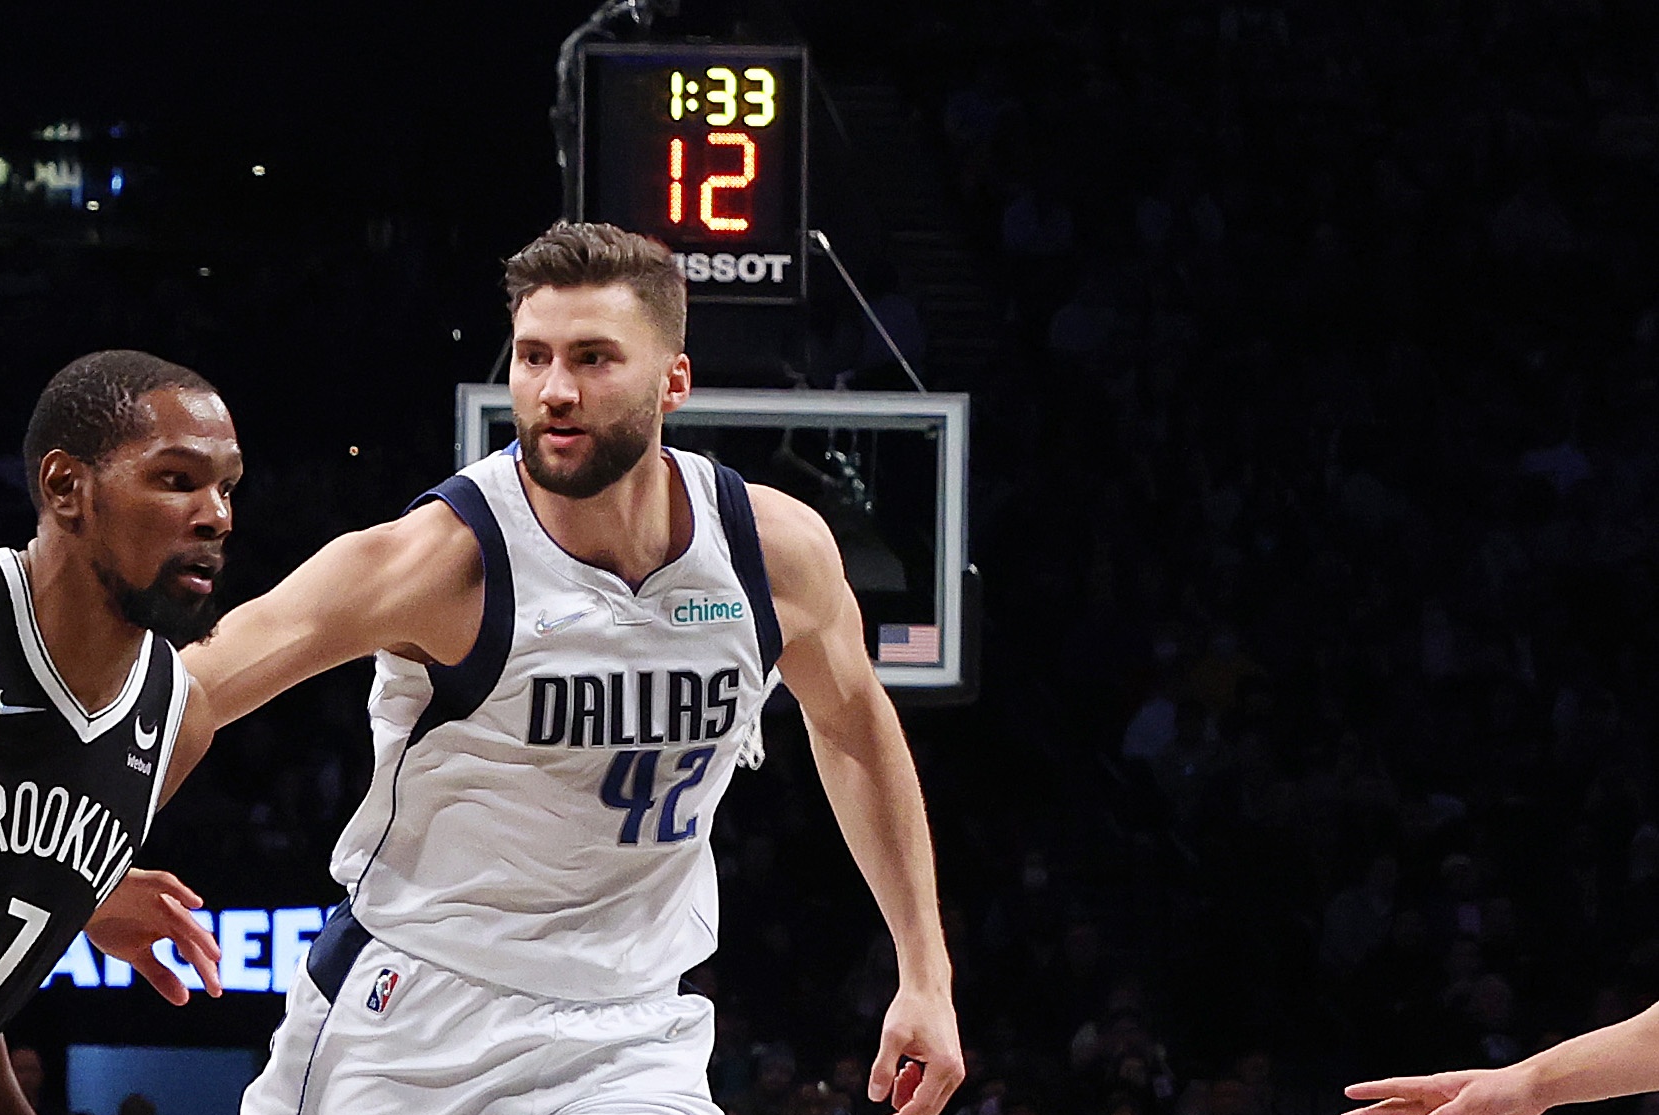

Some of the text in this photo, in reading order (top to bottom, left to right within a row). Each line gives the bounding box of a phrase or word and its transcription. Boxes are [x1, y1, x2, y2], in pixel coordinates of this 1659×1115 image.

[670, 66, 775, 127] 1:33
[669, 132, 757, 232] 12
[672, 253, 792, 283] ISSOT
[674, 598, 743, 624] chime
[526, 667, 740, 747] DALLAS
[600, 747, 717, 845] 42
